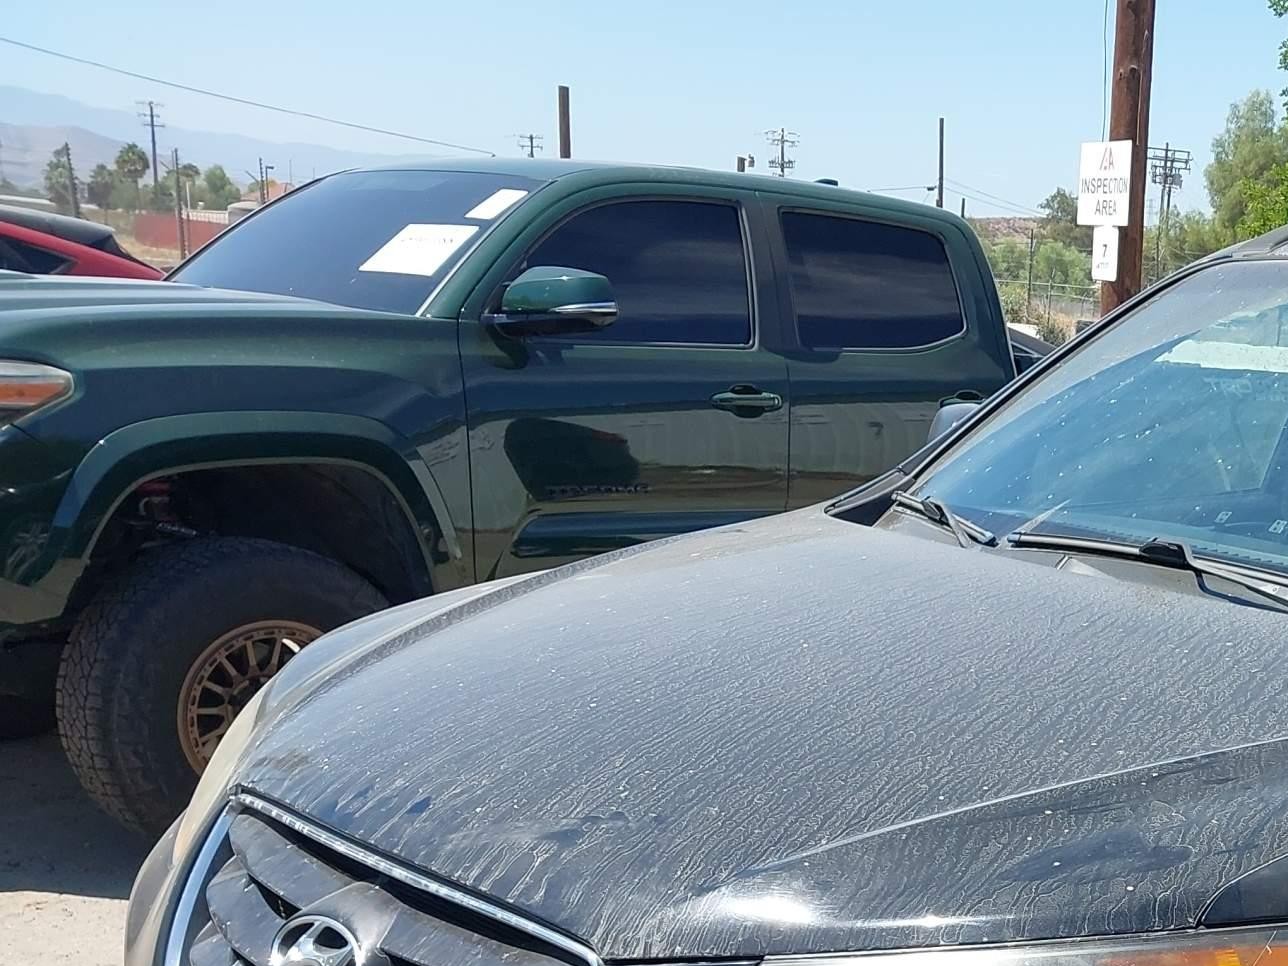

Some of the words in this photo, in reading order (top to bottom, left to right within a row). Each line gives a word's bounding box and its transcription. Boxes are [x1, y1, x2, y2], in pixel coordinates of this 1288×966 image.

[1080, 177, 1128, 194] INSPECTION
[1094, 199, 1117, 216] AREA
[1102, 243, 1108, 258] 7
